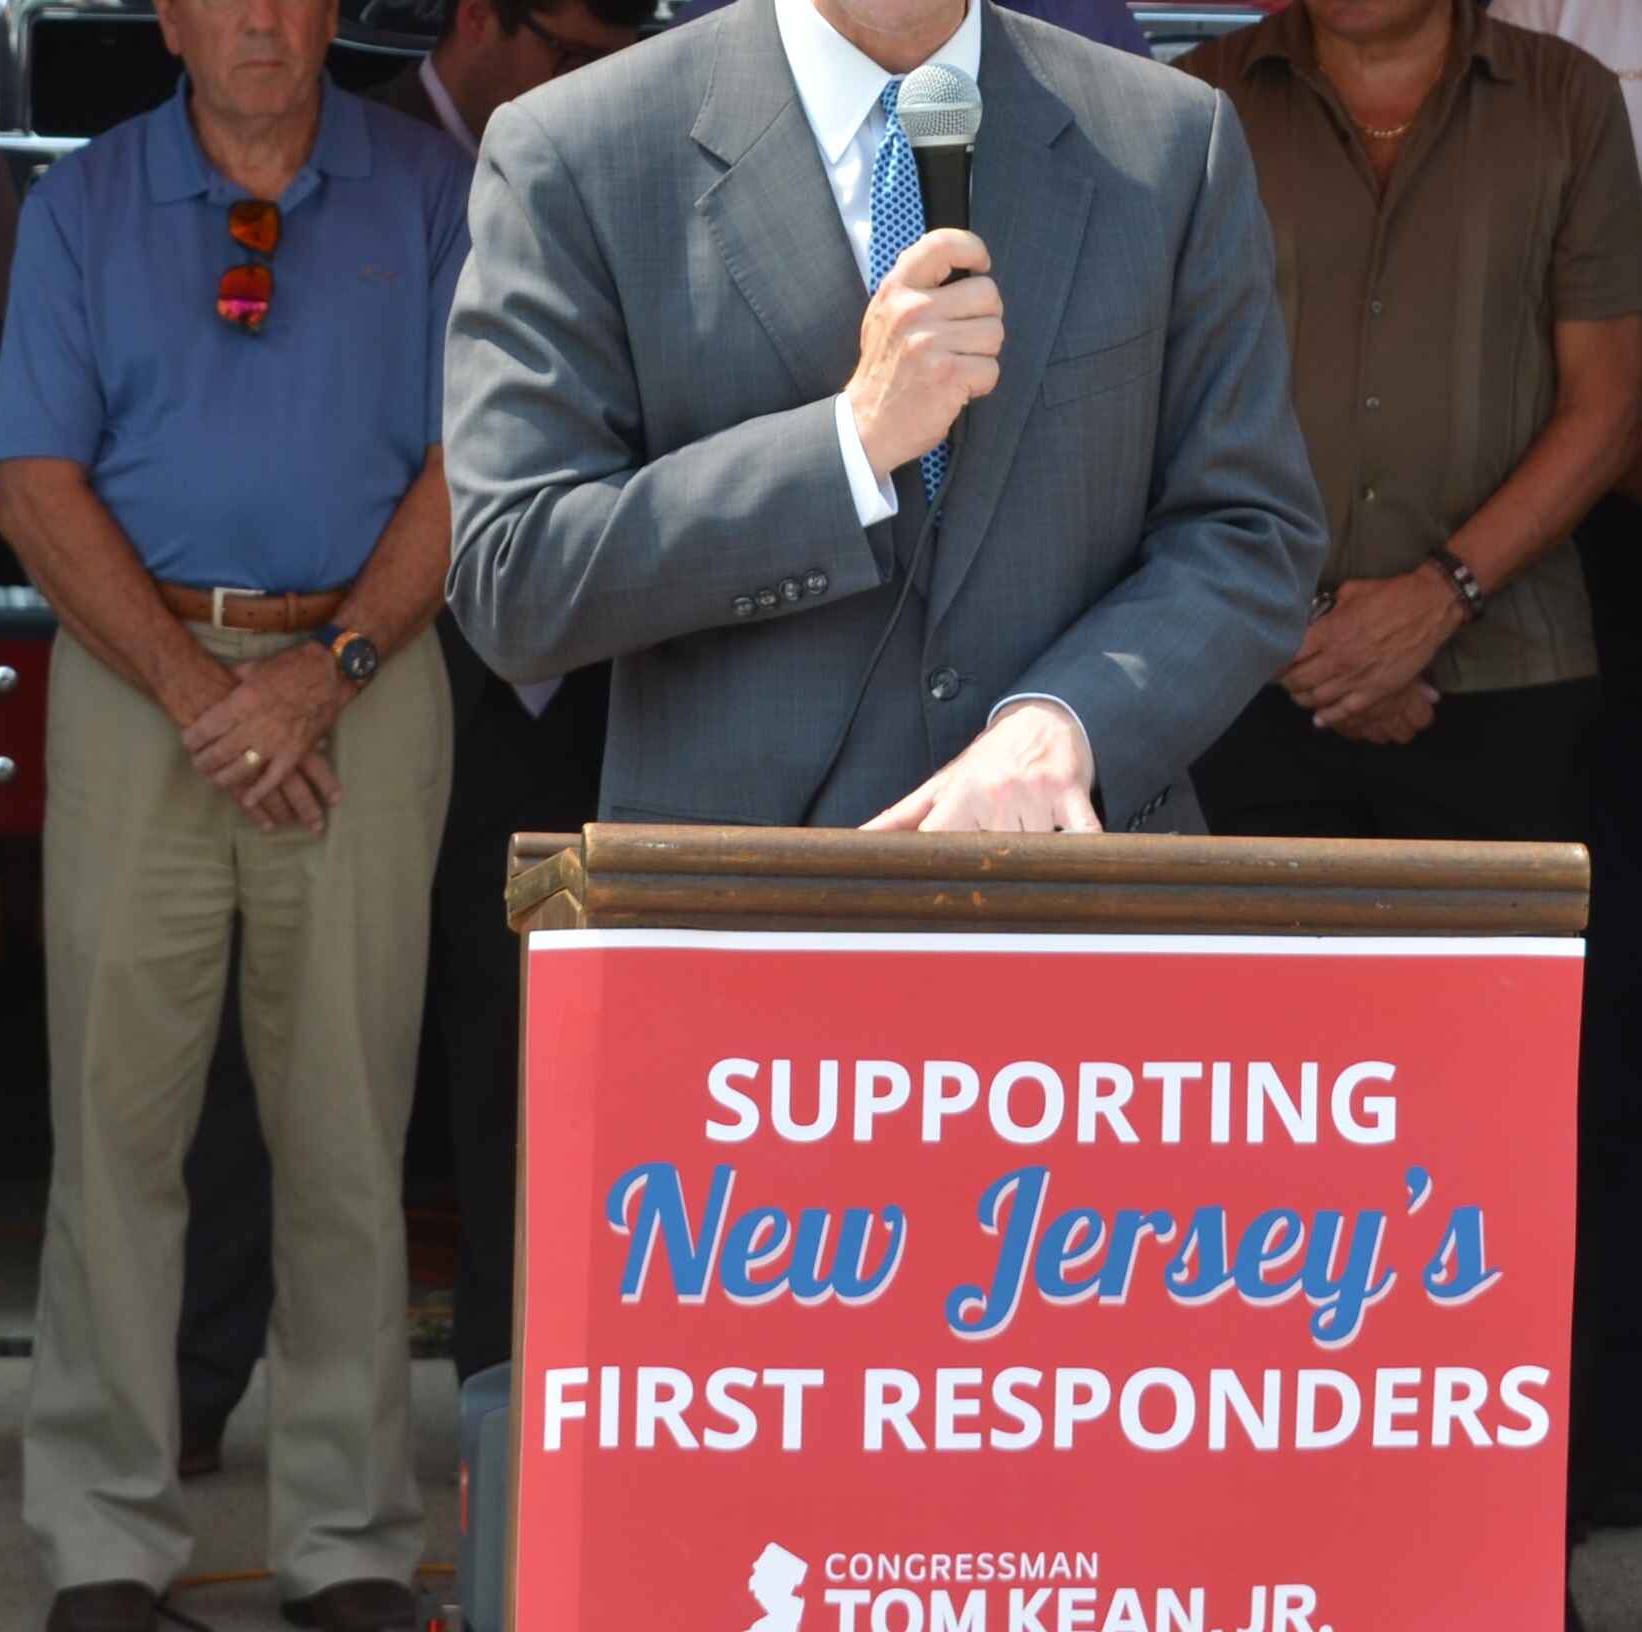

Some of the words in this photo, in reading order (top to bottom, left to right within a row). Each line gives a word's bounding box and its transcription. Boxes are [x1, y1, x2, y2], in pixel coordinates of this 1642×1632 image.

[704, 1056, 1398, 1146] SUPPORTING
[605, 1162, 907, 1306] New
[945, 1166, 1501, 1350] Jersey's
[542, 1365, 824, 1453] FIRST
[862, 1365, 1551, 1453] RESPONDERS
[824, 1551, 1098, 1581] CONGRESSMAN
[824, 1587, 988, 1632] TOM
[1235, 1583, 1334, 1632] JR.
